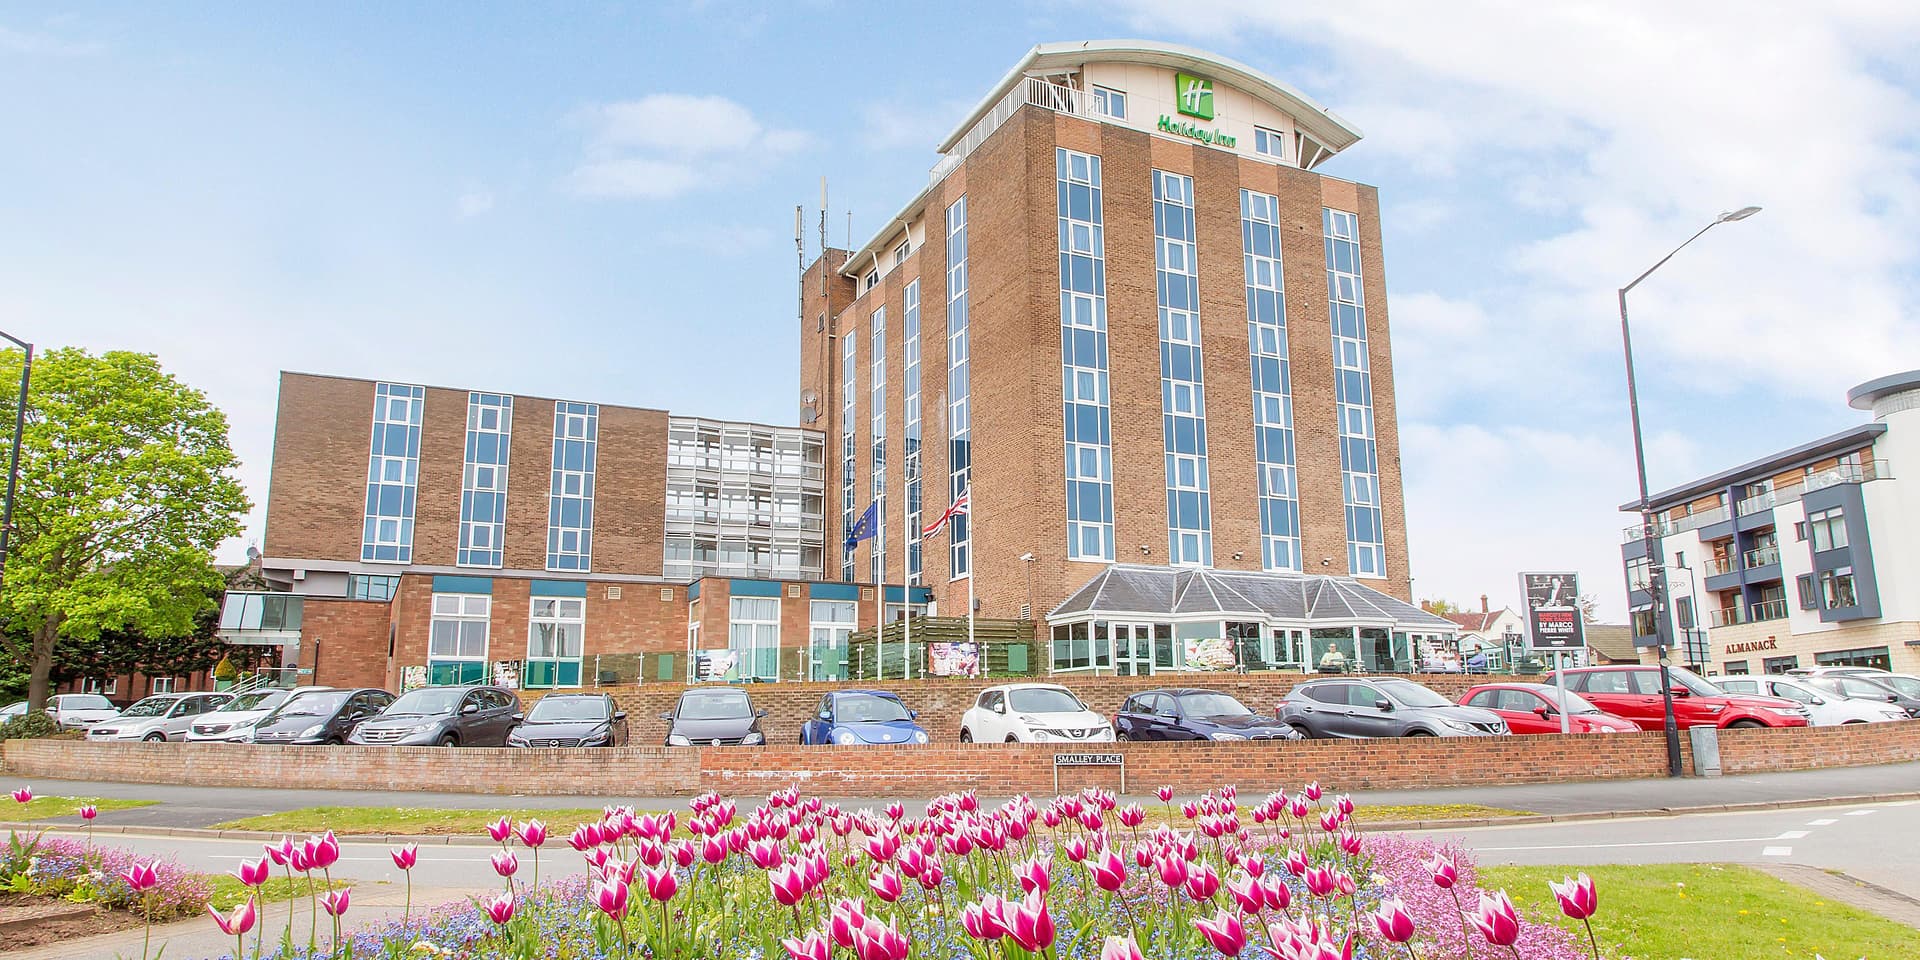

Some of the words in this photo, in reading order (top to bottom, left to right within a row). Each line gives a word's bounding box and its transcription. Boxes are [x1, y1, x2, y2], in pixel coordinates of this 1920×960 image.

[1157, 114, 1213, 145] Holiday
[1214, 128, 1237, 148] Inn
[1725, 639, 1777, 654] ALMANACK
[1057, 755, 1093, 763] SMALLEY
[1096, 755, 1121, 763] PLACE
